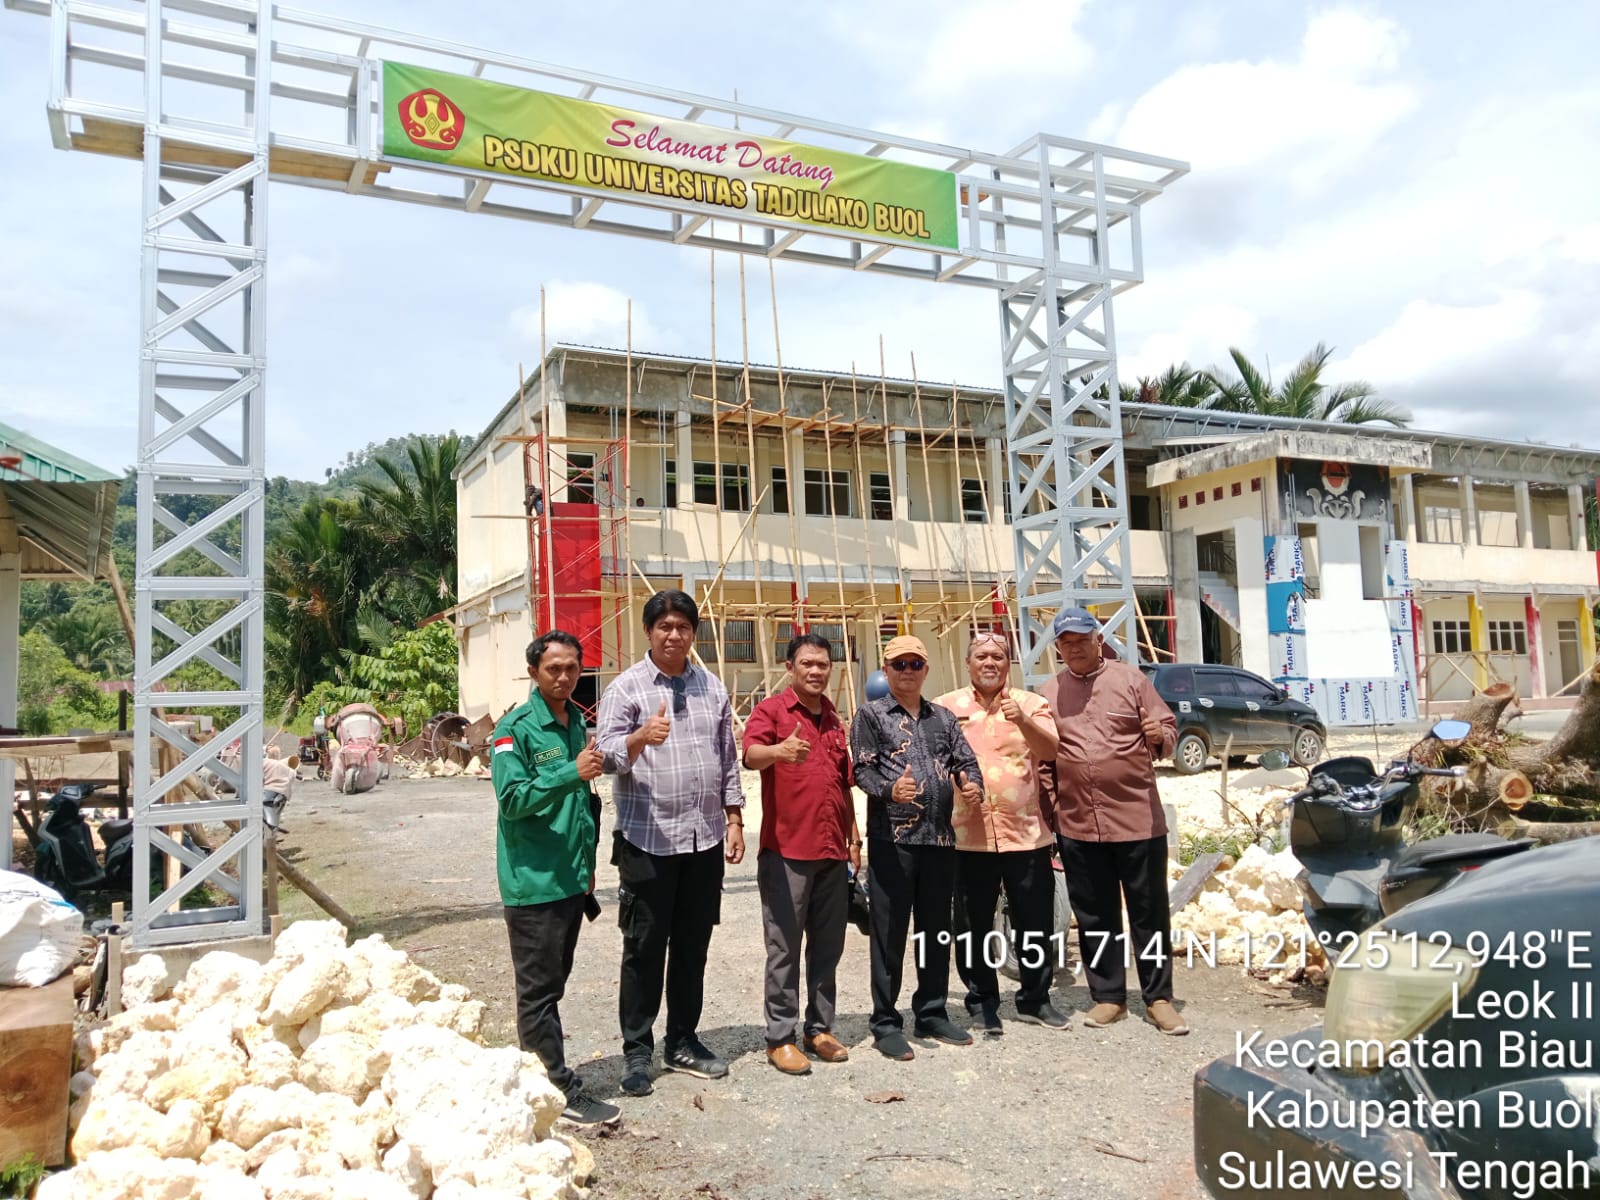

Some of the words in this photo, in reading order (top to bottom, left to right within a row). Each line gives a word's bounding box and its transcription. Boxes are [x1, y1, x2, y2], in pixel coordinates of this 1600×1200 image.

[606, 119, 727, 164] Selamat
[735, 141, 835, 190] Datang
[484, 135, 578, 180] PSDKU
[584, 152, 748, 209] UNIVERSITAS
[752, 182, 869, 229] TADULAKO
[874, 202, 930, 239] BUOL
[1286, 636, 1294, 670] MARKS
[1339, 687, 1347, 721] MARKS
[1362, 686, 1370, 720] MARKS
